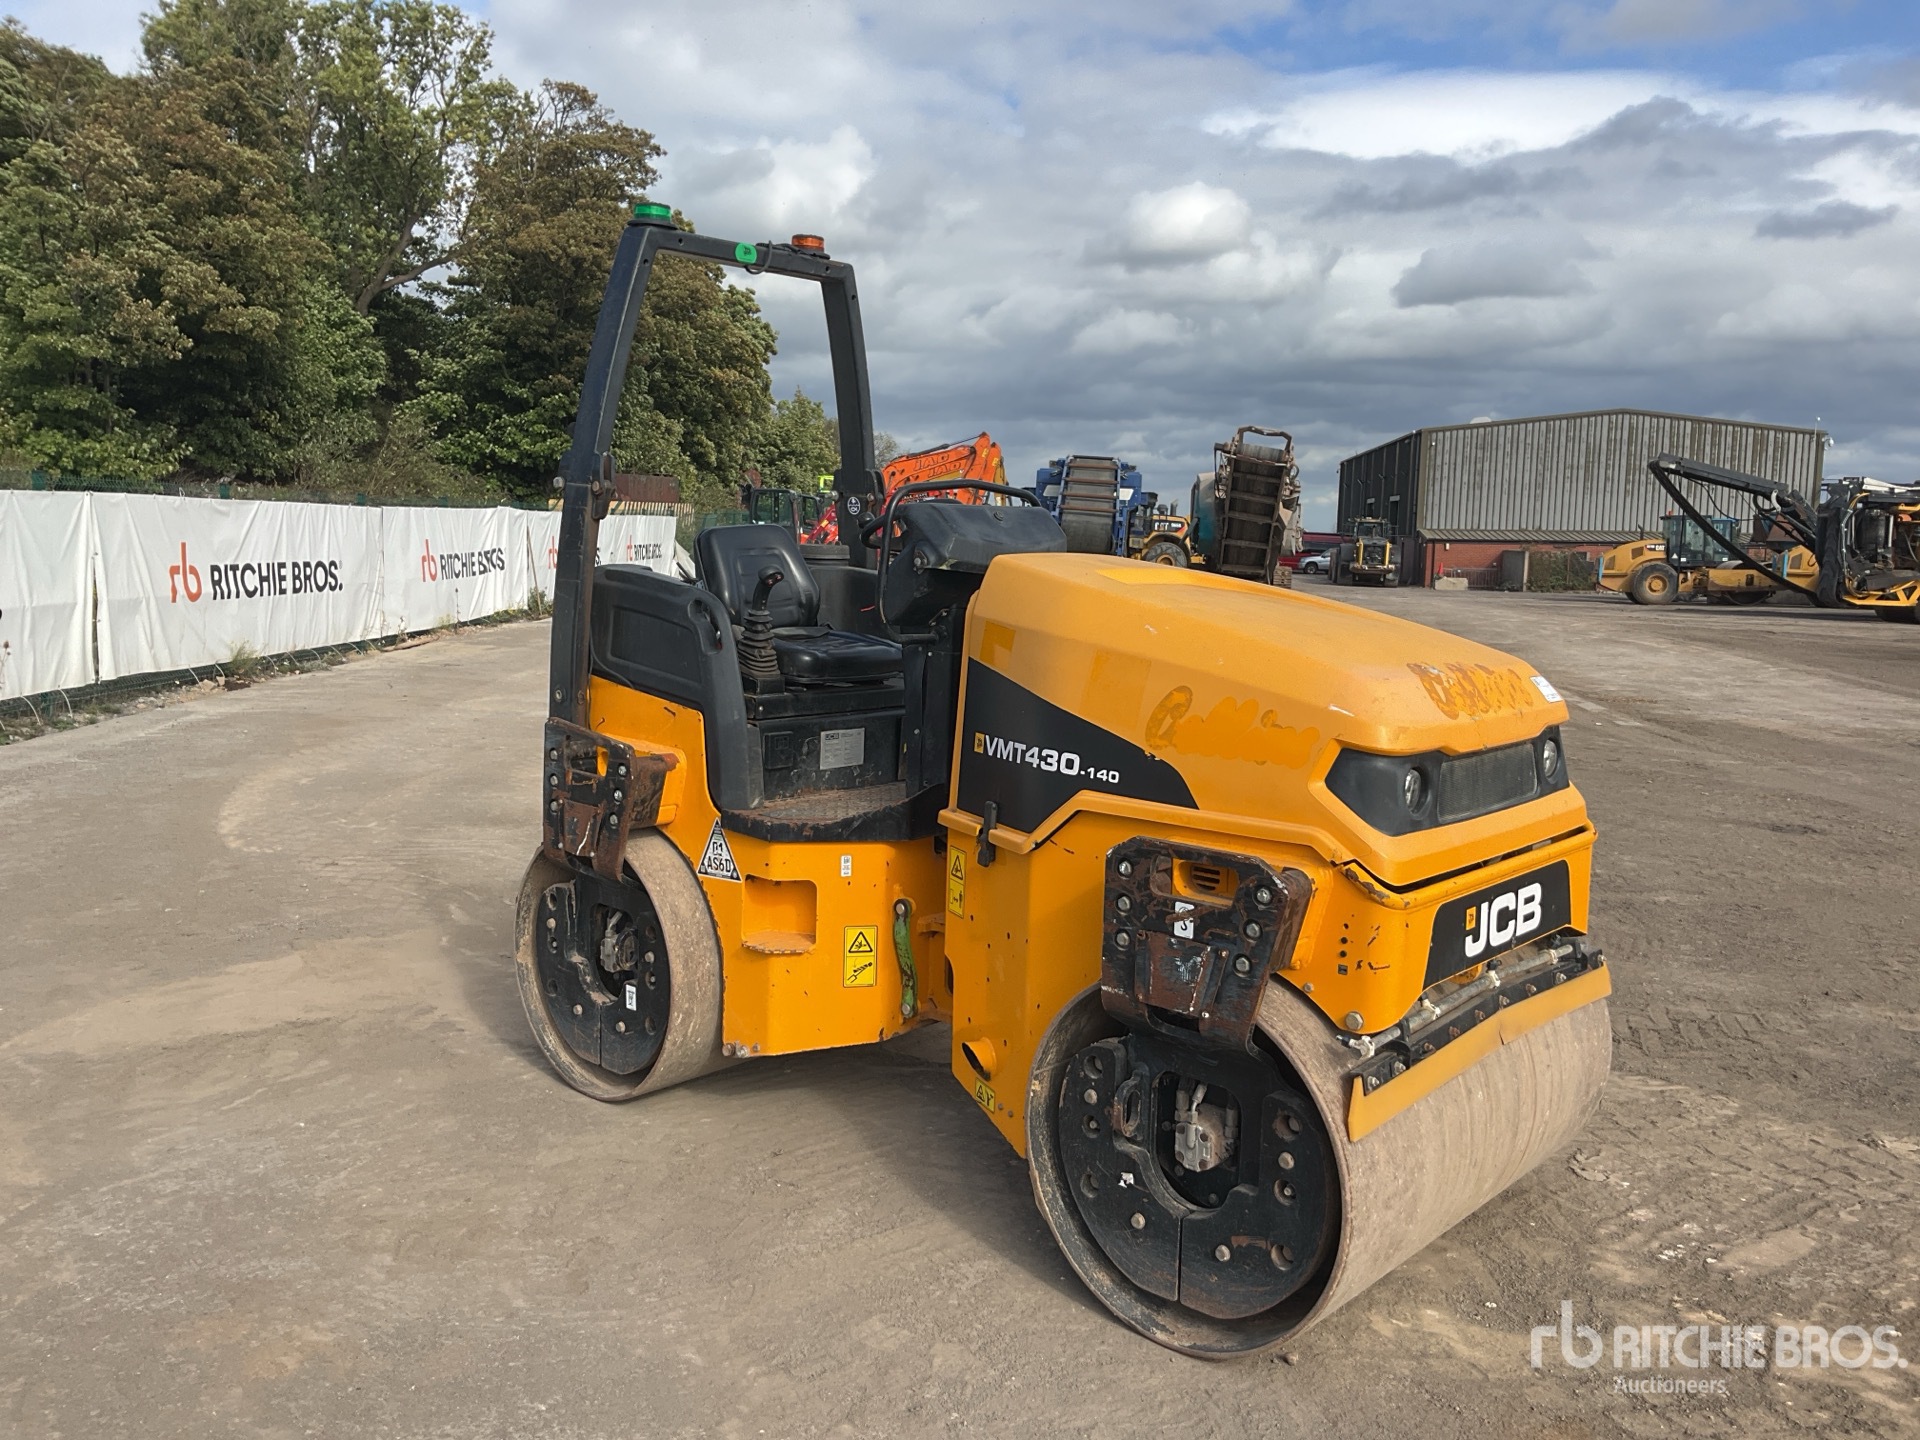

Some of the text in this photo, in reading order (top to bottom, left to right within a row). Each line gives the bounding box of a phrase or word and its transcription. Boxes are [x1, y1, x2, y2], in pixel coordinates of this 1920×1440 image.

[210, 561, 287, 600] RITCHIE
[291, 560, 343, 594] BROS.
[440, 552, 476, 580] RITCHIE
[707, 855, 732, 873] AS6D
[1464, 882, 1542, 958] JCB
